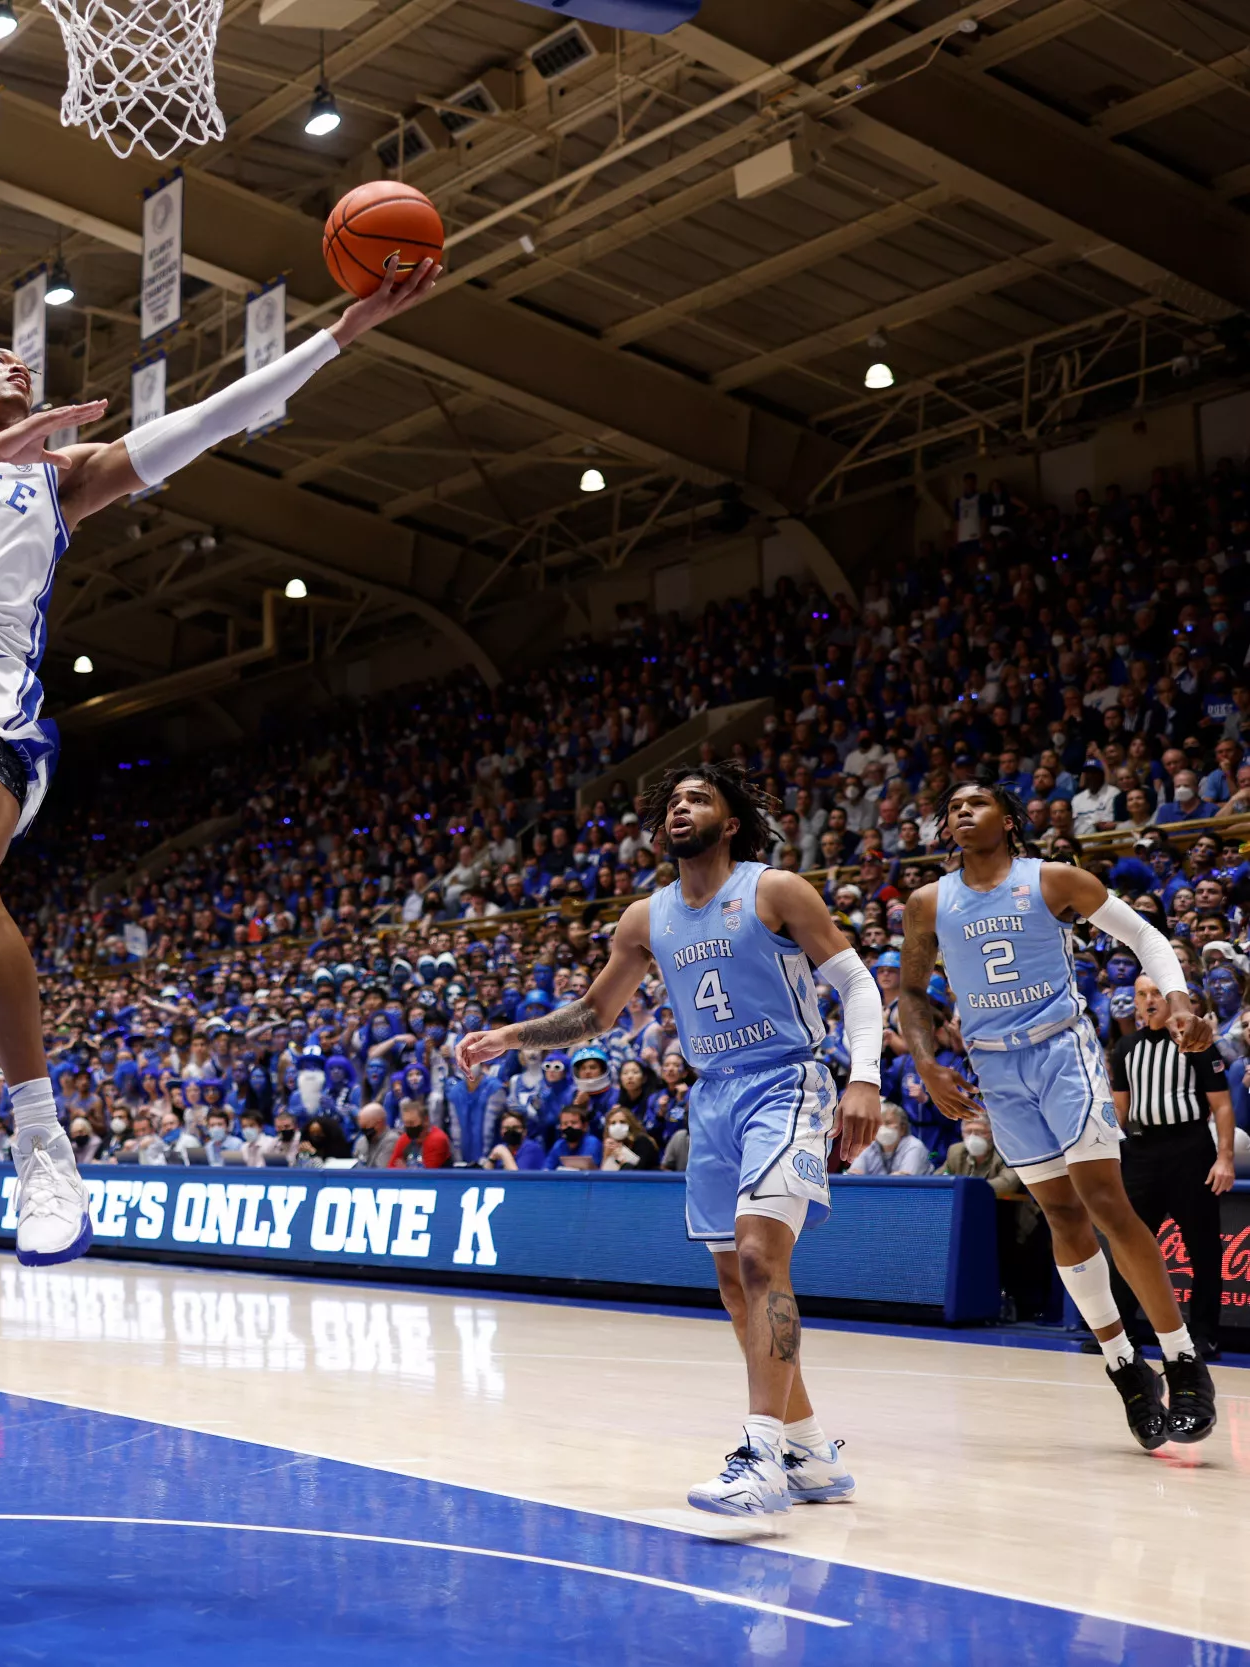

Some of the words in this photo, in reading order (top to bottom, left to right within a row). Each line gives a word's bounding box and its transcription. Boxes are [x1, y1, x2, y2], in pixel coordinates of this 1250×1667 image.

[962, 915, 1024, 941] NORTH
[673, 938, 734, 971] NORTH
[981, 938, 1020, 985] 2
[694, 968, 734, 1023] 4
[967, 981, 1055, 1009] CAROLINA
[690, 1019, 778, 1055] CAROLINA
[0, 1176, 168, 1240] TRE'S
[172, 1181, 307, 1249] ONLY
[310, 1186, 437, 1257] ONE
[452, 1186, 505, 1266] K
